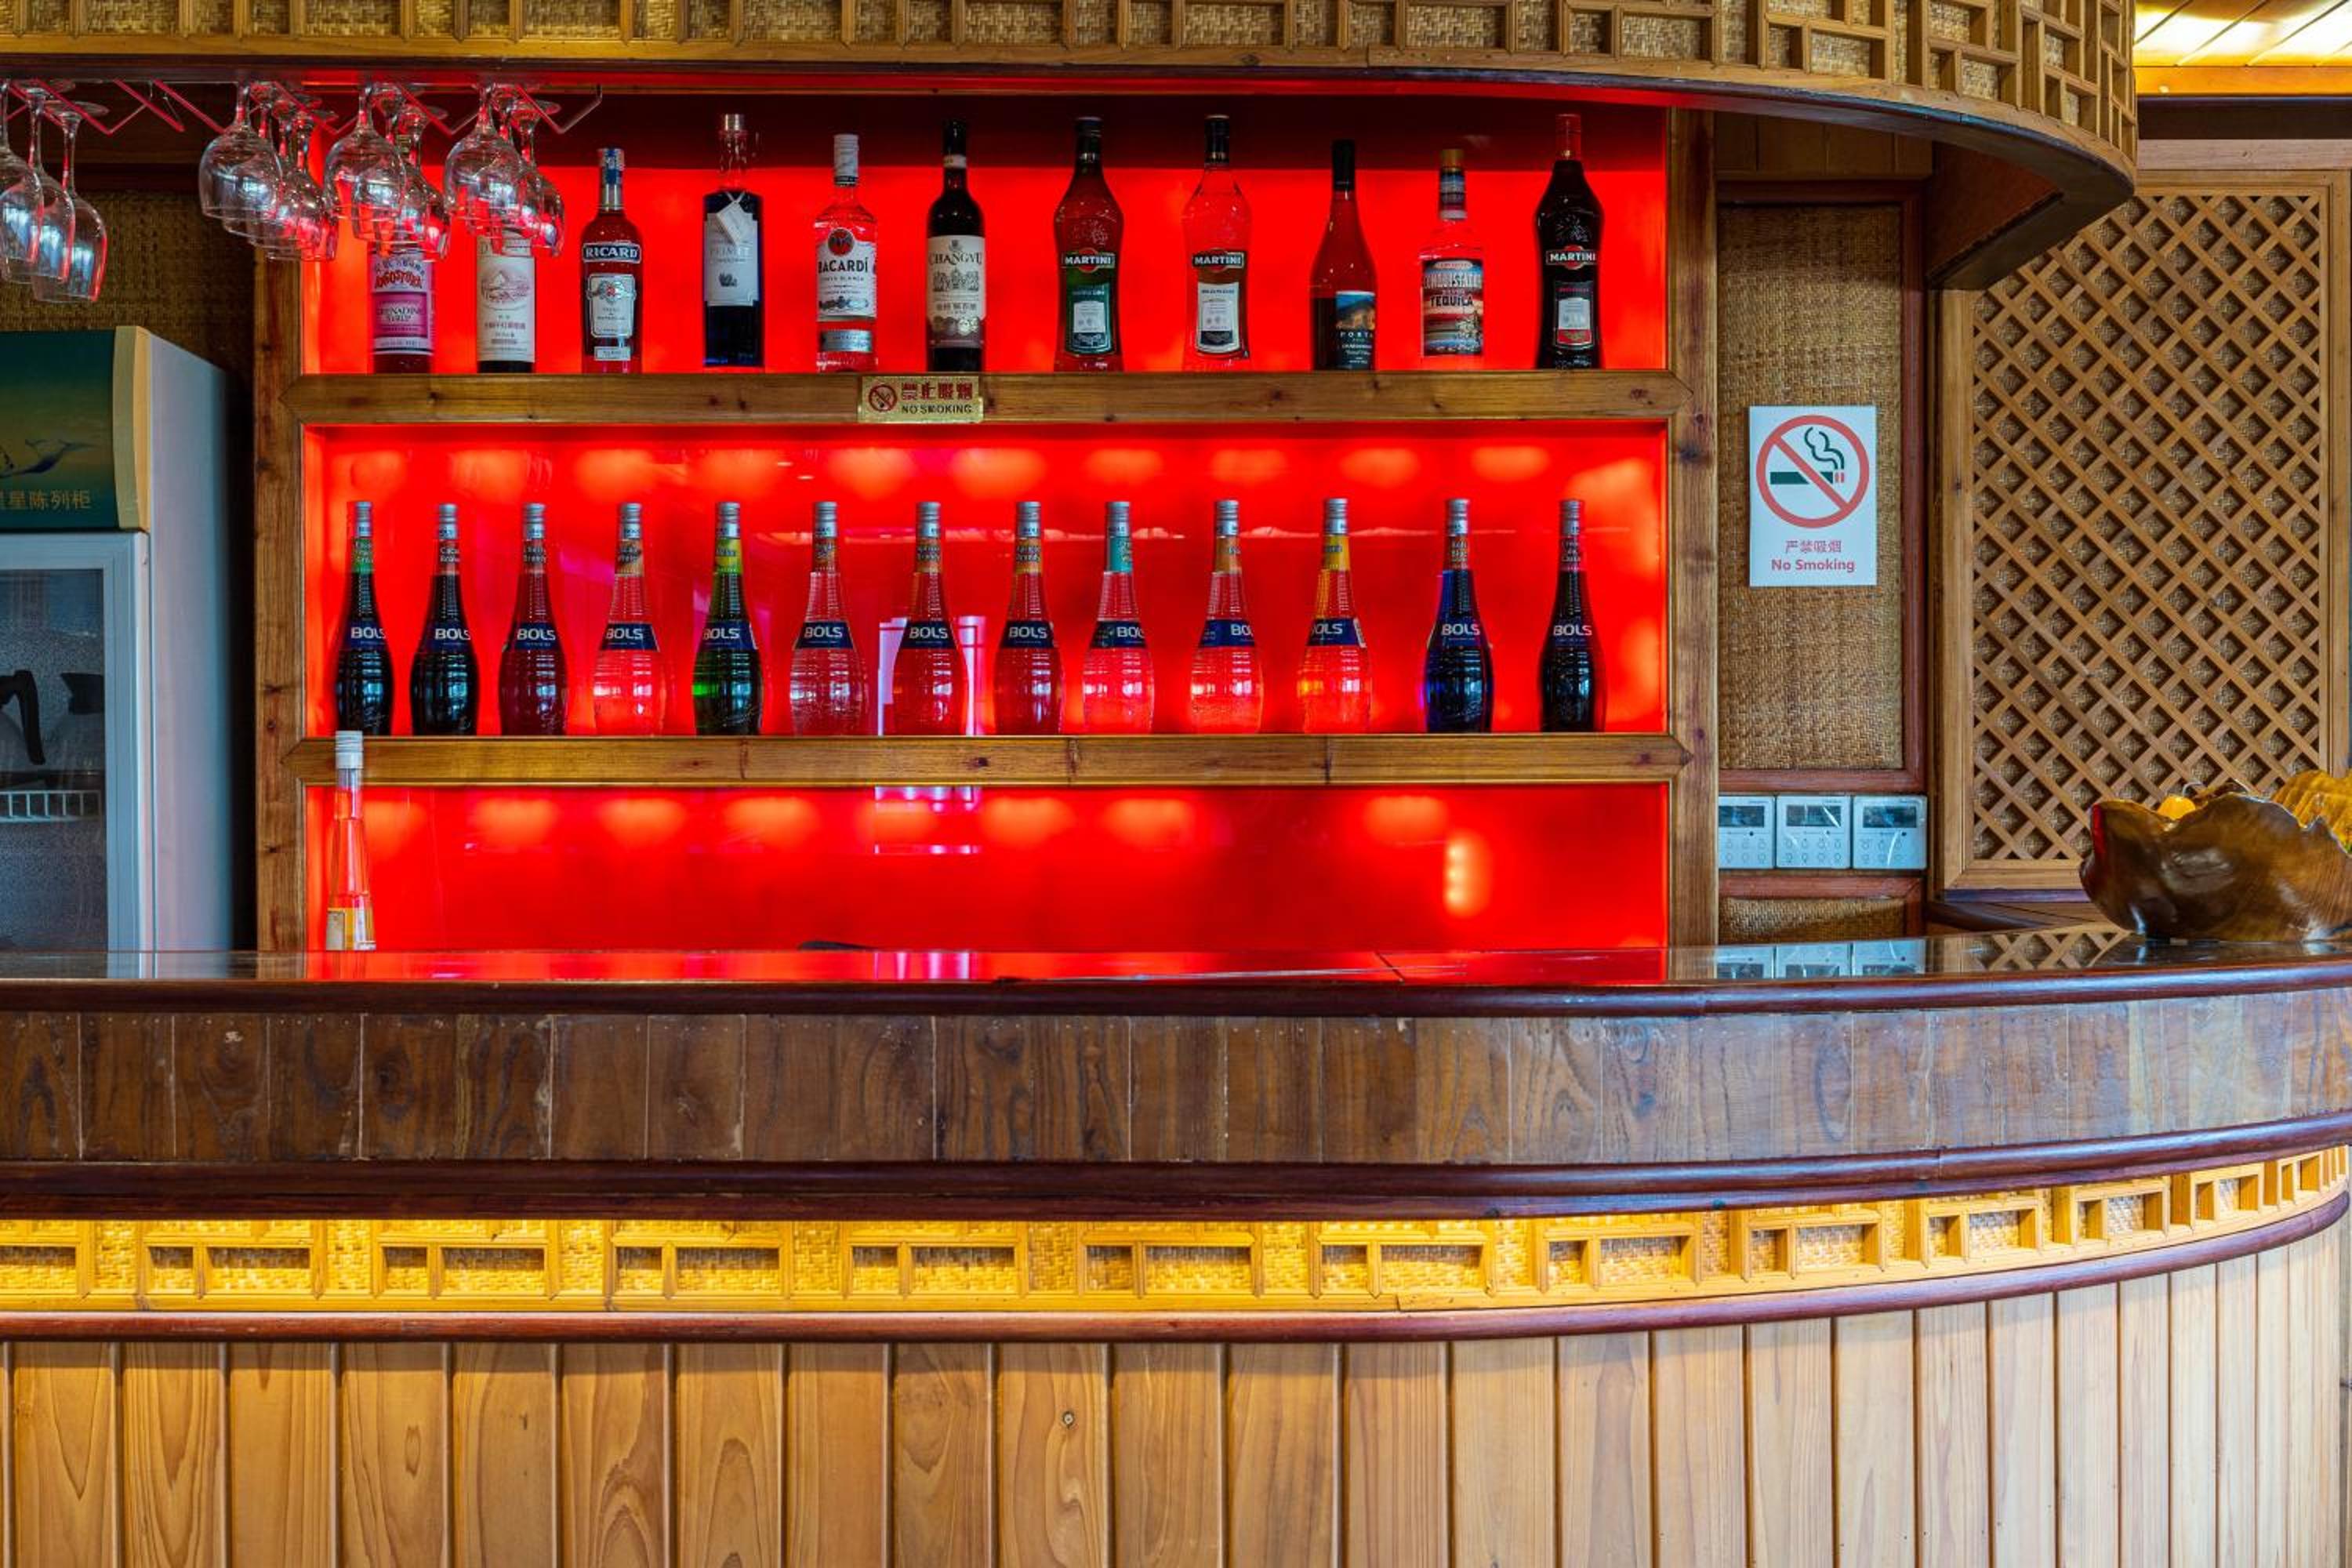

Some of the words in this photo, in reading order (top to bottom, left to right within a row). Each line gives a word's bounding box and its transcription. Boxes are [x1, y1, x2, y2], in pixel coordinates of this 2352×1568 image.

[585, 246, 638, 259] RICARD
[927, 252, 983, 266] CHANGYU
[1549, 252, 1596, 262] MARTINI
[1064, 256, 1112, 265] MARTINI
[1194, 256, 1241, 265] MARTINI
[1429, 292, 1474, 307] TEQUILA
[902, 404, 918, 415] NO
[920, 404, 972, 415] SMOKING
[0, 488, 92, 511] 星陈列柜
[1785, 539, 1842, 554] 严禁吸烟
[1771, 559, 1791, 571] No
[1795, 558, 1856, 573] Smoking
[351, 626, 386, 639] BOLS
[435, 627, 470, 641] BOLS
[517, 628, 556, 641] BOLS
[606, 627, 644, 640] BOLS
[704, 627, 741, 640] BOLS
[804, 626, 843, 638] BOLS
[909, 626, 949, 639] BOLS
[1008, 626, 1048, 639] BOLS
[1441, 622, 1480, 636] BOLS
[1553, 624, 1592, 637] BOLS
